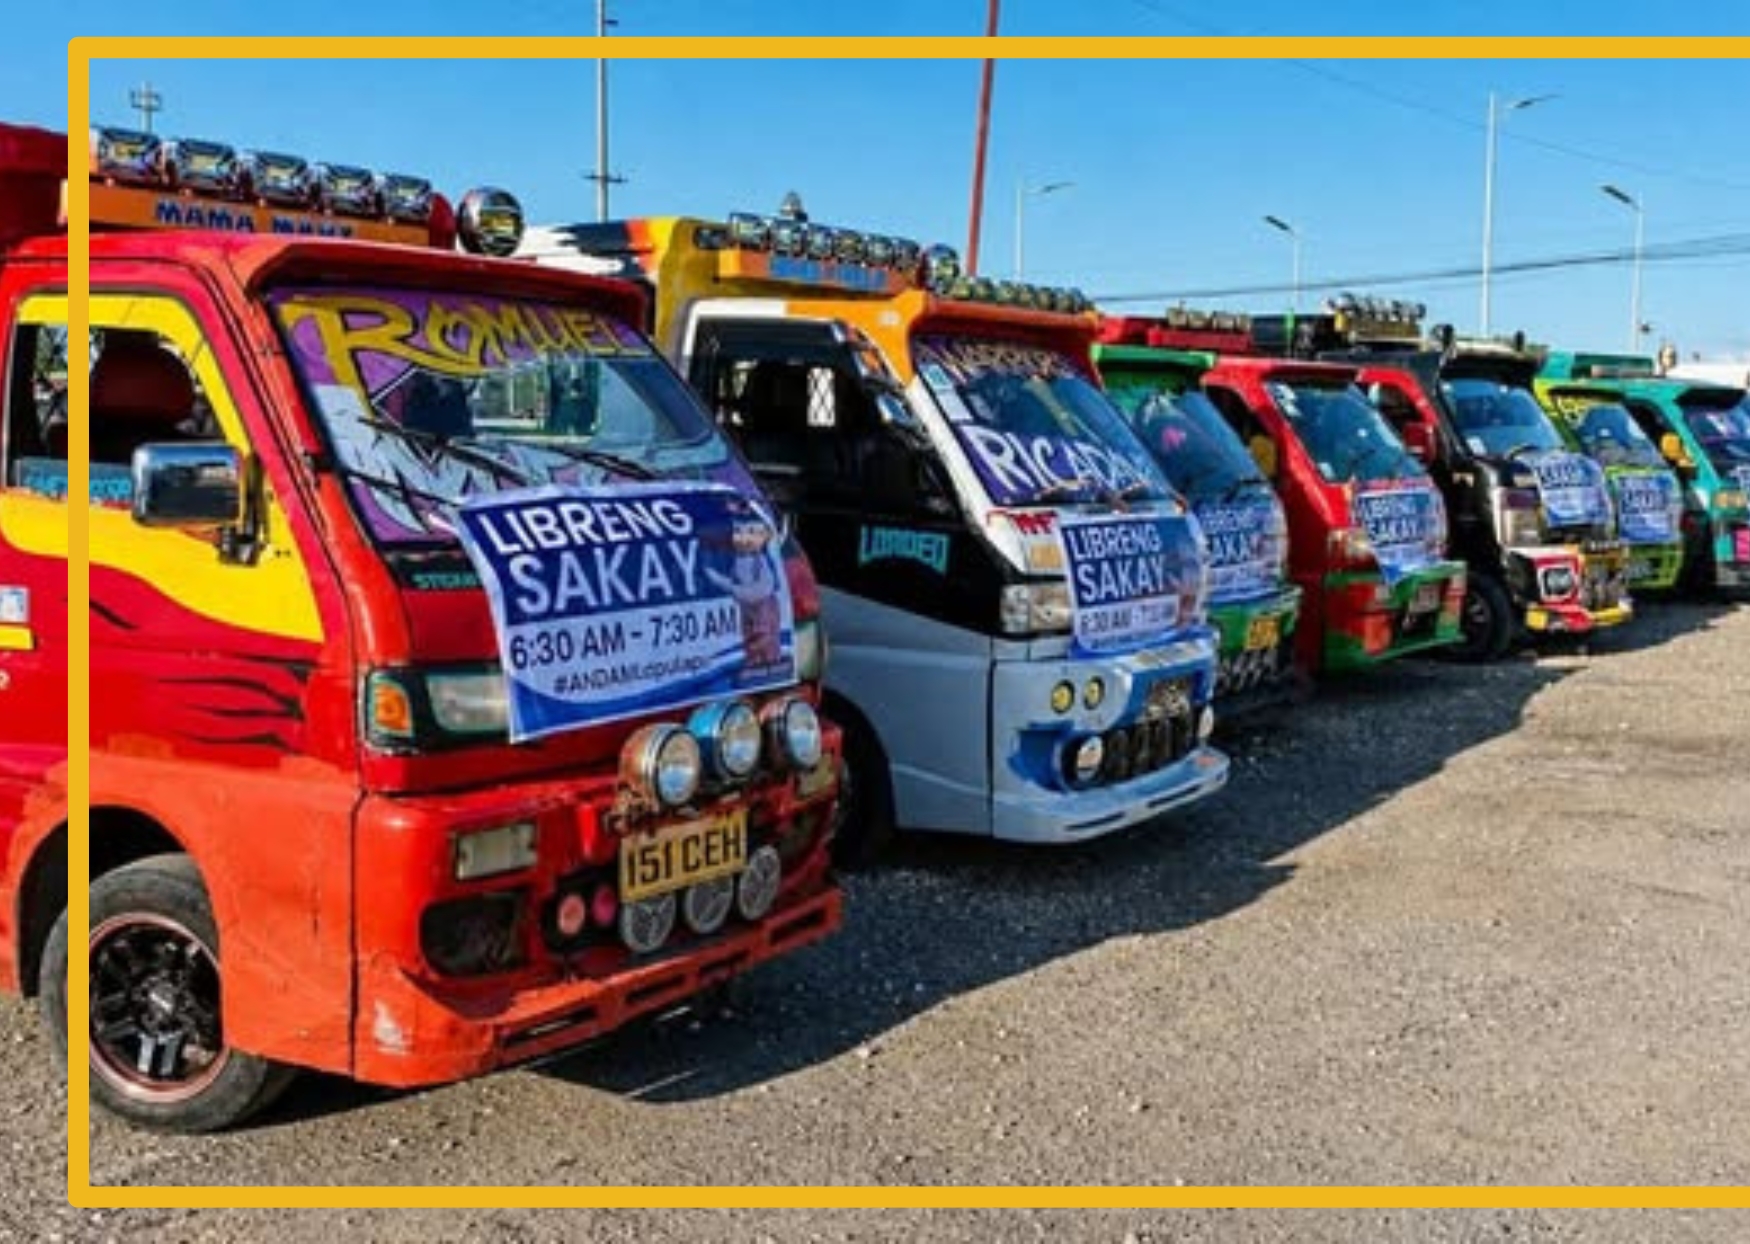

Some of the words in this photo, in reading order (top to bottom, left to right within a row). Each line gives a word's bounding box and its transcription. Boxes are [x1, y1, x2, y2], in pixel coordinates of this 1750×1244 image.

[157, 199, 254, 233] MAMA
[479, 500, 694, 554] LIBRENG
[1067, 523, 1163, 561] LIBRENG
[509, 539, 699, 615] SAKAY
[1077, 554, 1164, 602] SAKAY
[510, 630, 574, 670] 6:30
[581, 621, 626, 658] AM
[650, 611, 699, 648] 7:30
[704, 605, 738, 640] AM
[682, 824, 741, 872] CEH
